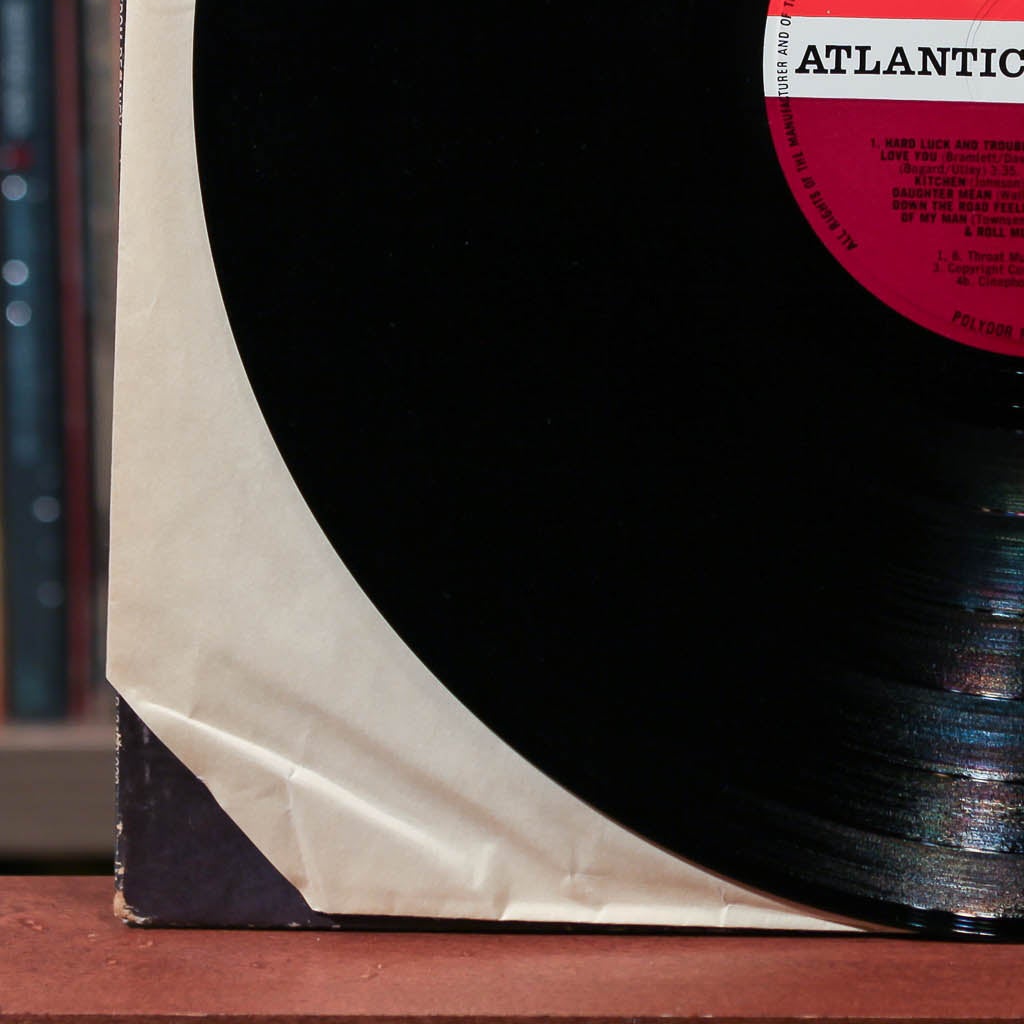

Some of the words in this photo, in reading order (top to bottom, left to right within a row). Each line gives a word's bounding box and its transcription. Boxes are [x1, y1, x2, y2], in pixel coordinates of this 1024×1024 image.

[779, 12, 792, 26] OF
[777, 31, 790, 55] AND
[795, 45, 1024, 78] ATLANTIC
[886, 137, 916, 149] HARD
[920, 138, 950, 150] LUCK
[956, 139, 978, 151] AND
[881, 150, 908, 161] LOVE
[915, 151, 937, 162] YOU
